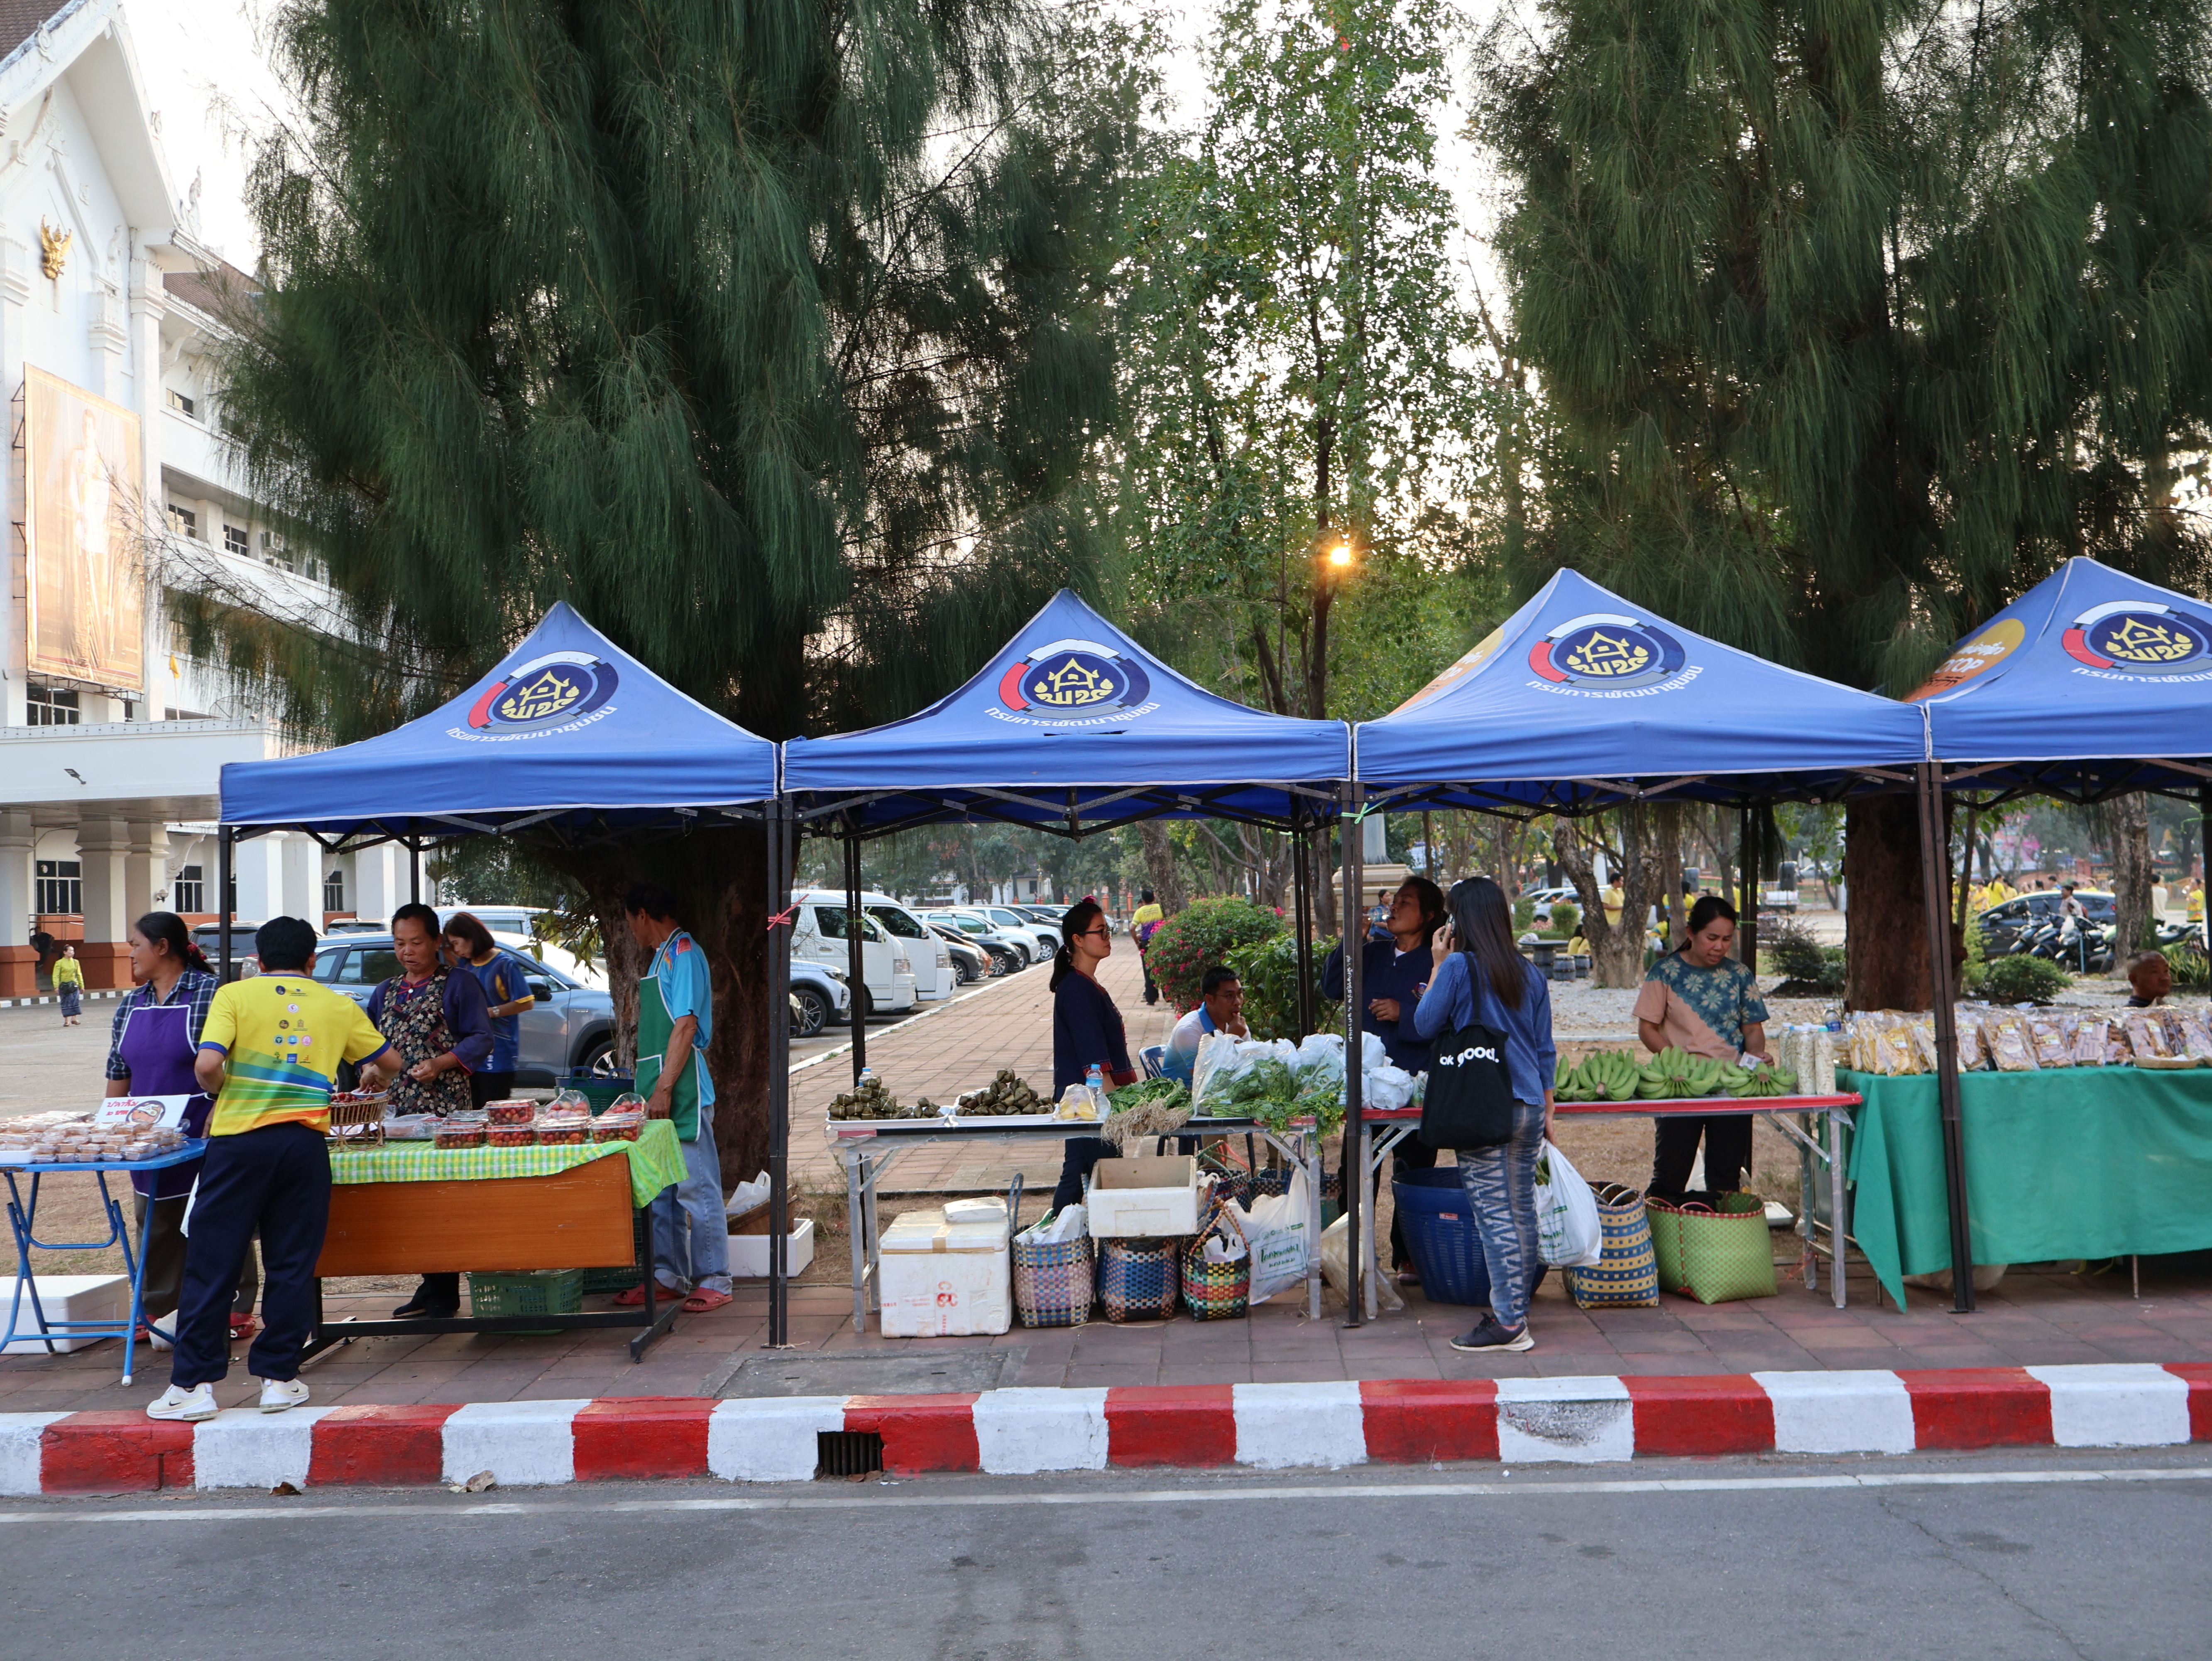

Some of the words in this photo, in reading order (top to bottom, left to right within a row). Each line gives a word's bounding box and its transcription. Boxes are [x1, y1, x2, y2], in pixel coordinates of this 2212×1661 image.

[1525, 665, 1704, 699] กรมการพัฒนาชุมชน
[445, 706, 619, 742] กรมการพัฒนาชุมชน
[984, 701, 1161, 727] กรมการพัฒนาชุมชน
[1439, 1055, 1454, 1066] ok
[1457, 1046, 1500, 1068] good.
[107, 1099, 139, 1107] ปลาส้ม
